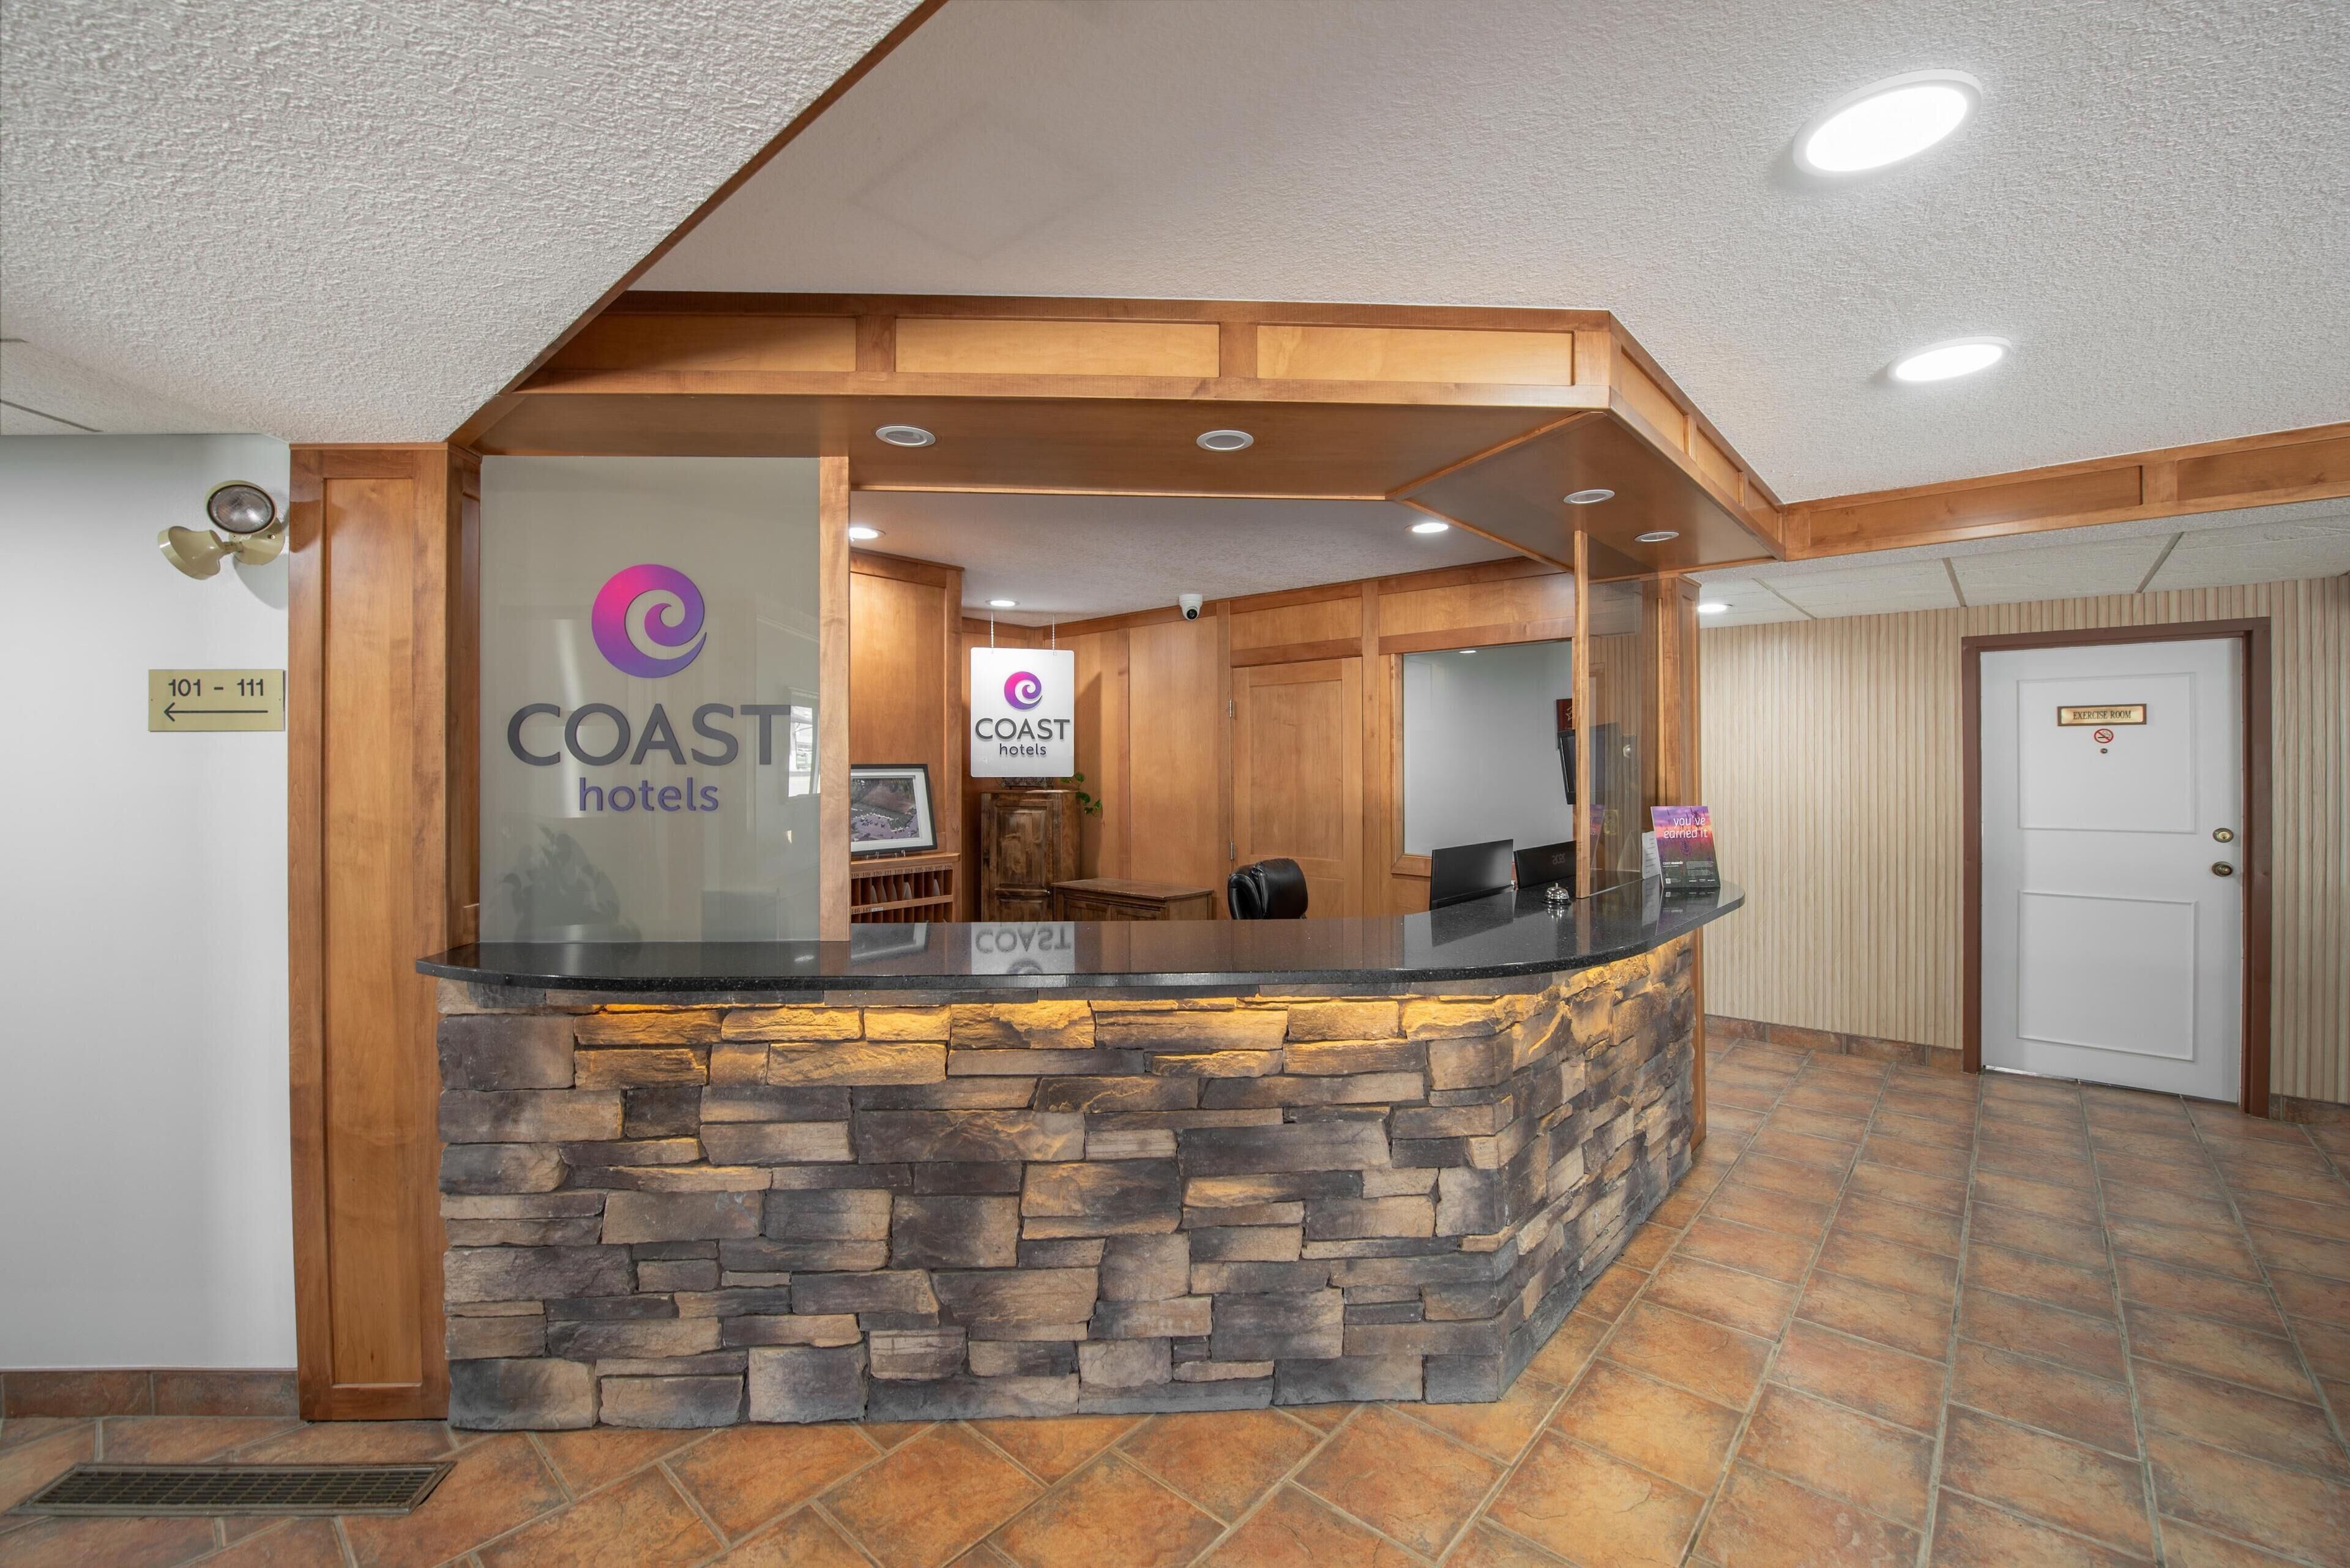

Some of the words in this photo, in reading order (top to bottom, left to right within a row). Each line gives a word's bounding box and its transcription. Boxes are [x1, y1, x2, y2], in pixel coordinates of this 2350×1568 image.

[168, 678, 201, 696] 101
[236, 678, 264, 696] 111
[2073, 711, 2108, 720] EXERCISE
[2110, 710, 2132, 719] ROOM
[507, 703, 791, 766] COAST
[975, 718, 1070, 740] COAST
[999, 743, 1046, 756] hotels
[578, 777, 719, 812] hotels
[1673, 815, 1706, 828] you've
[1664, 827, 1698, 839] earned
[1701, 827, 1708, 838] it
[1551, 853, 1565, 865] acer
